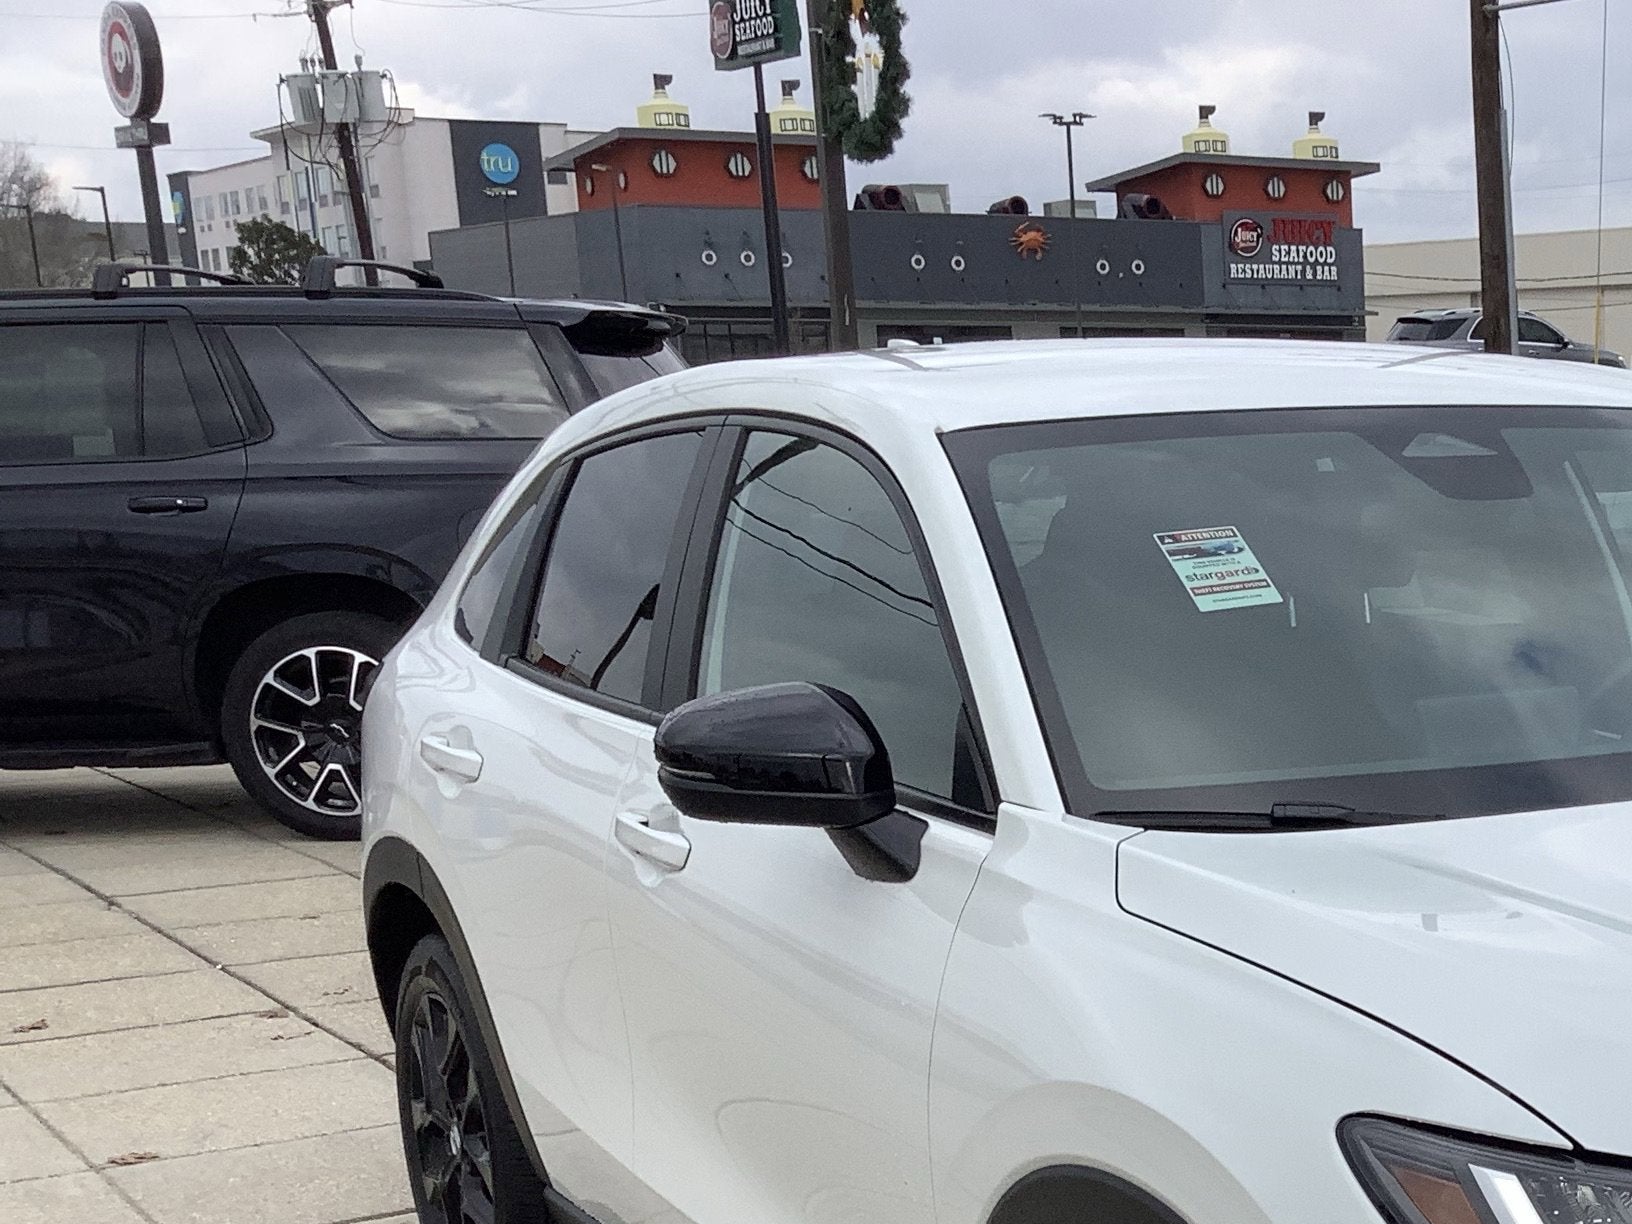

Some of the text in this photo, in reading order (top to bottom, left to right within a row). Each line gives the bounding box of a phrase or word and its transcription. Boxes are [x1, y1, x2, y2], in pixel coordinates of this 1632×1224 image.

[735, 16, 775, 42] SEAFOOD
[480, 151, 513, 173] tru
[1266, 217, 1336, 245] JUICY
[1271, 244, 1336, 263] SEAFOOD
[1229, 263, 1338, 280] RESTAURANT & BAR
[1181, 530, 1233, 541] ATTENTION
[1185, 566, 1252, 581] stargard
